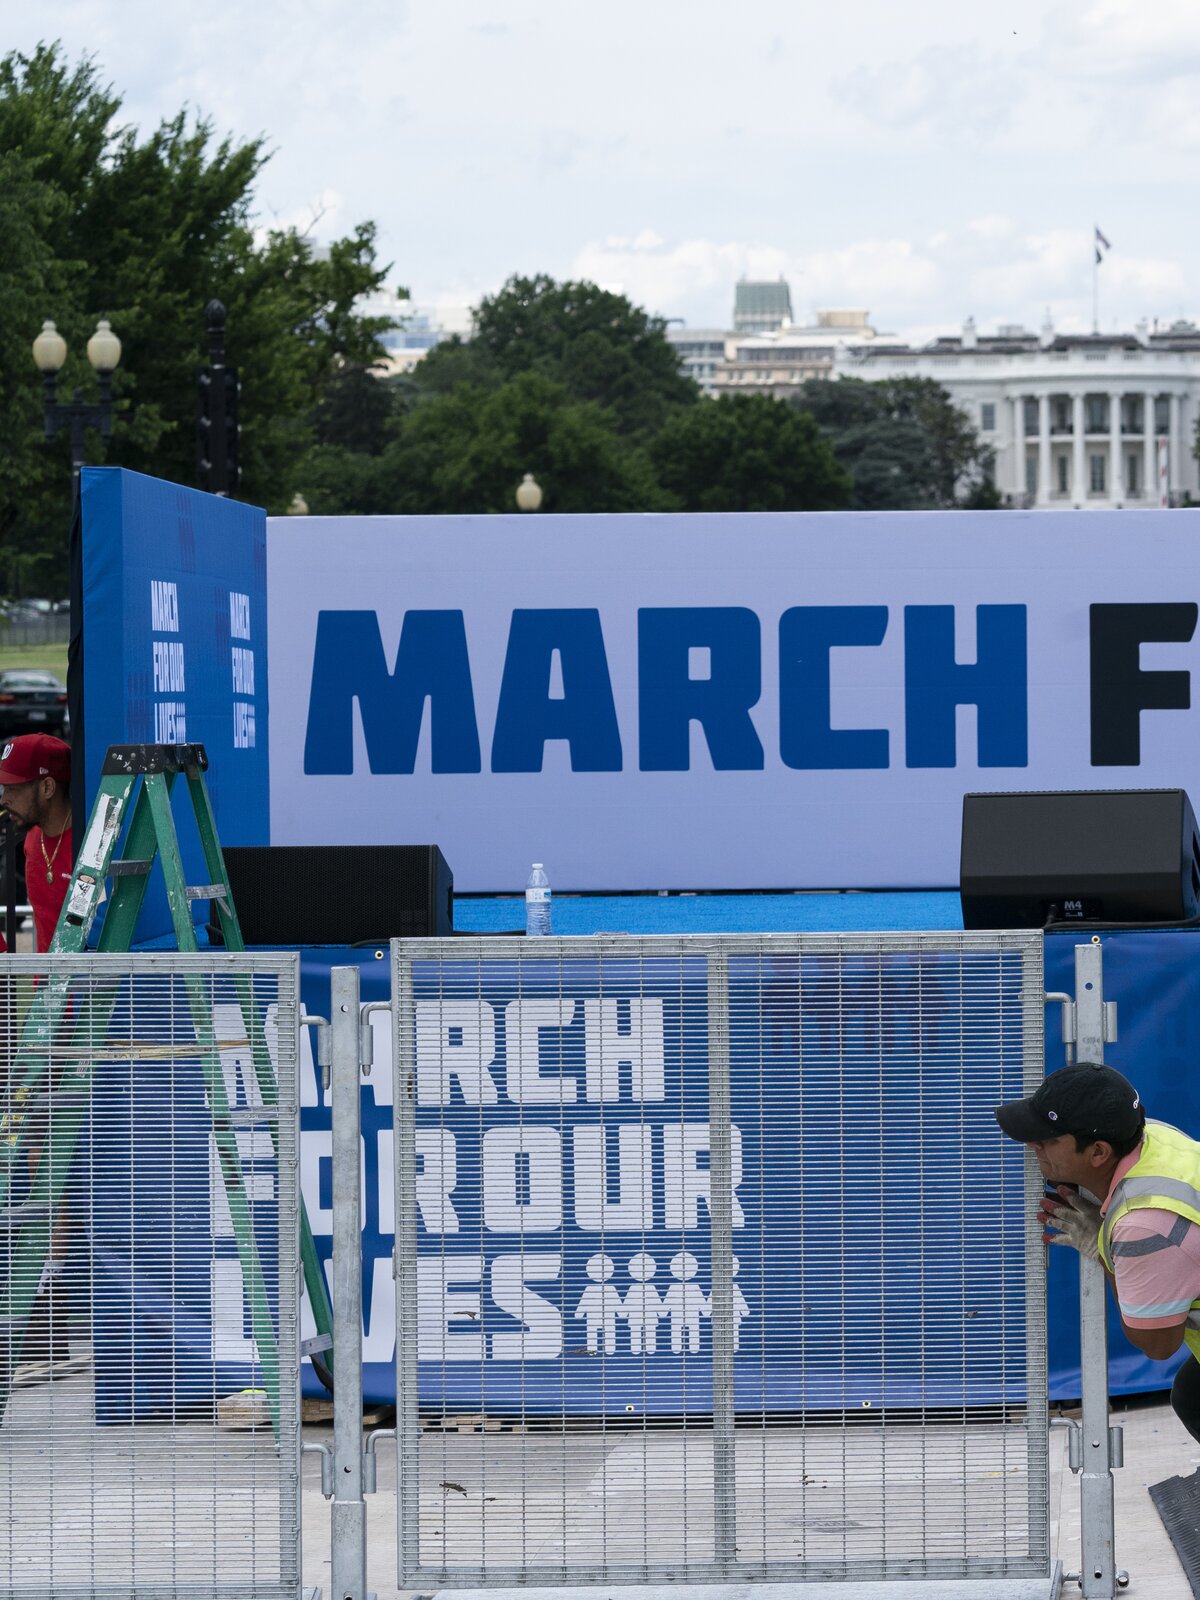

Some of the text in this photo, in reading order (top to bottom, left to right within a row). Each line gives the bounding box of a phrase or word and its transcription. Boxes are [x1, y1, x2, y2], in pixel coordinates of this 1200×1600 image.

[151, 580, 179, 632] MARCH
[304, 603, 1028, 775] MARCH
[1064, 900, 1082, 910] M4
[482, 1124, 745, 1231] OUR
[210, 1253, 564, 1363] LES
